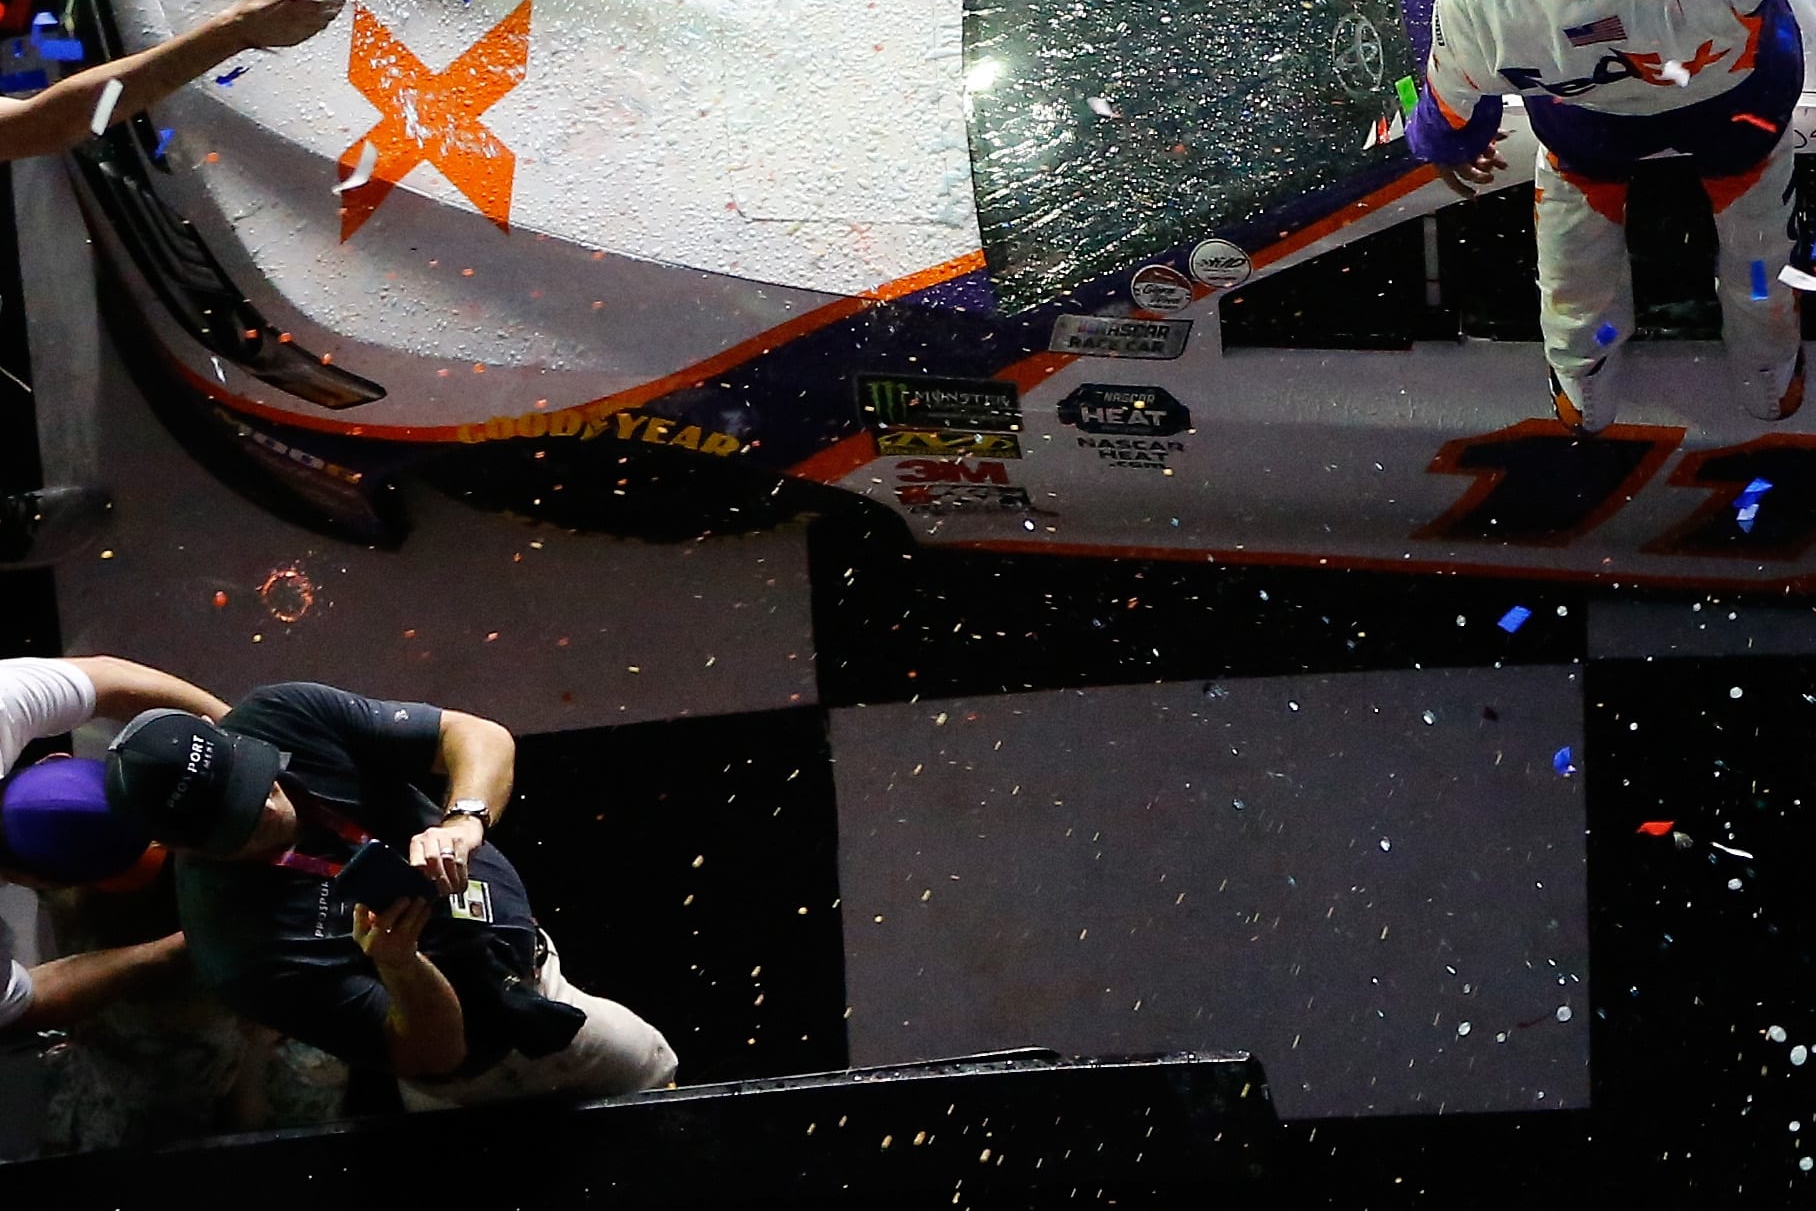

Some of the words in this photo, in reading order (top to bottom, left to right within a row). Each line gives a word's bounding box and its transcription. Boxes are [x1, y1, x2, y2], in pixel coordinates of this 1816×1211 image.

[1080, 406, 1168, 427] HEAT
[456, 409, 742, 457] GOODYEAR
[1077, 437, 1185, 452] NASCAR
[1098, 450, 1169, 462] HEAT
[895, 459, 1010, 485] 3M
